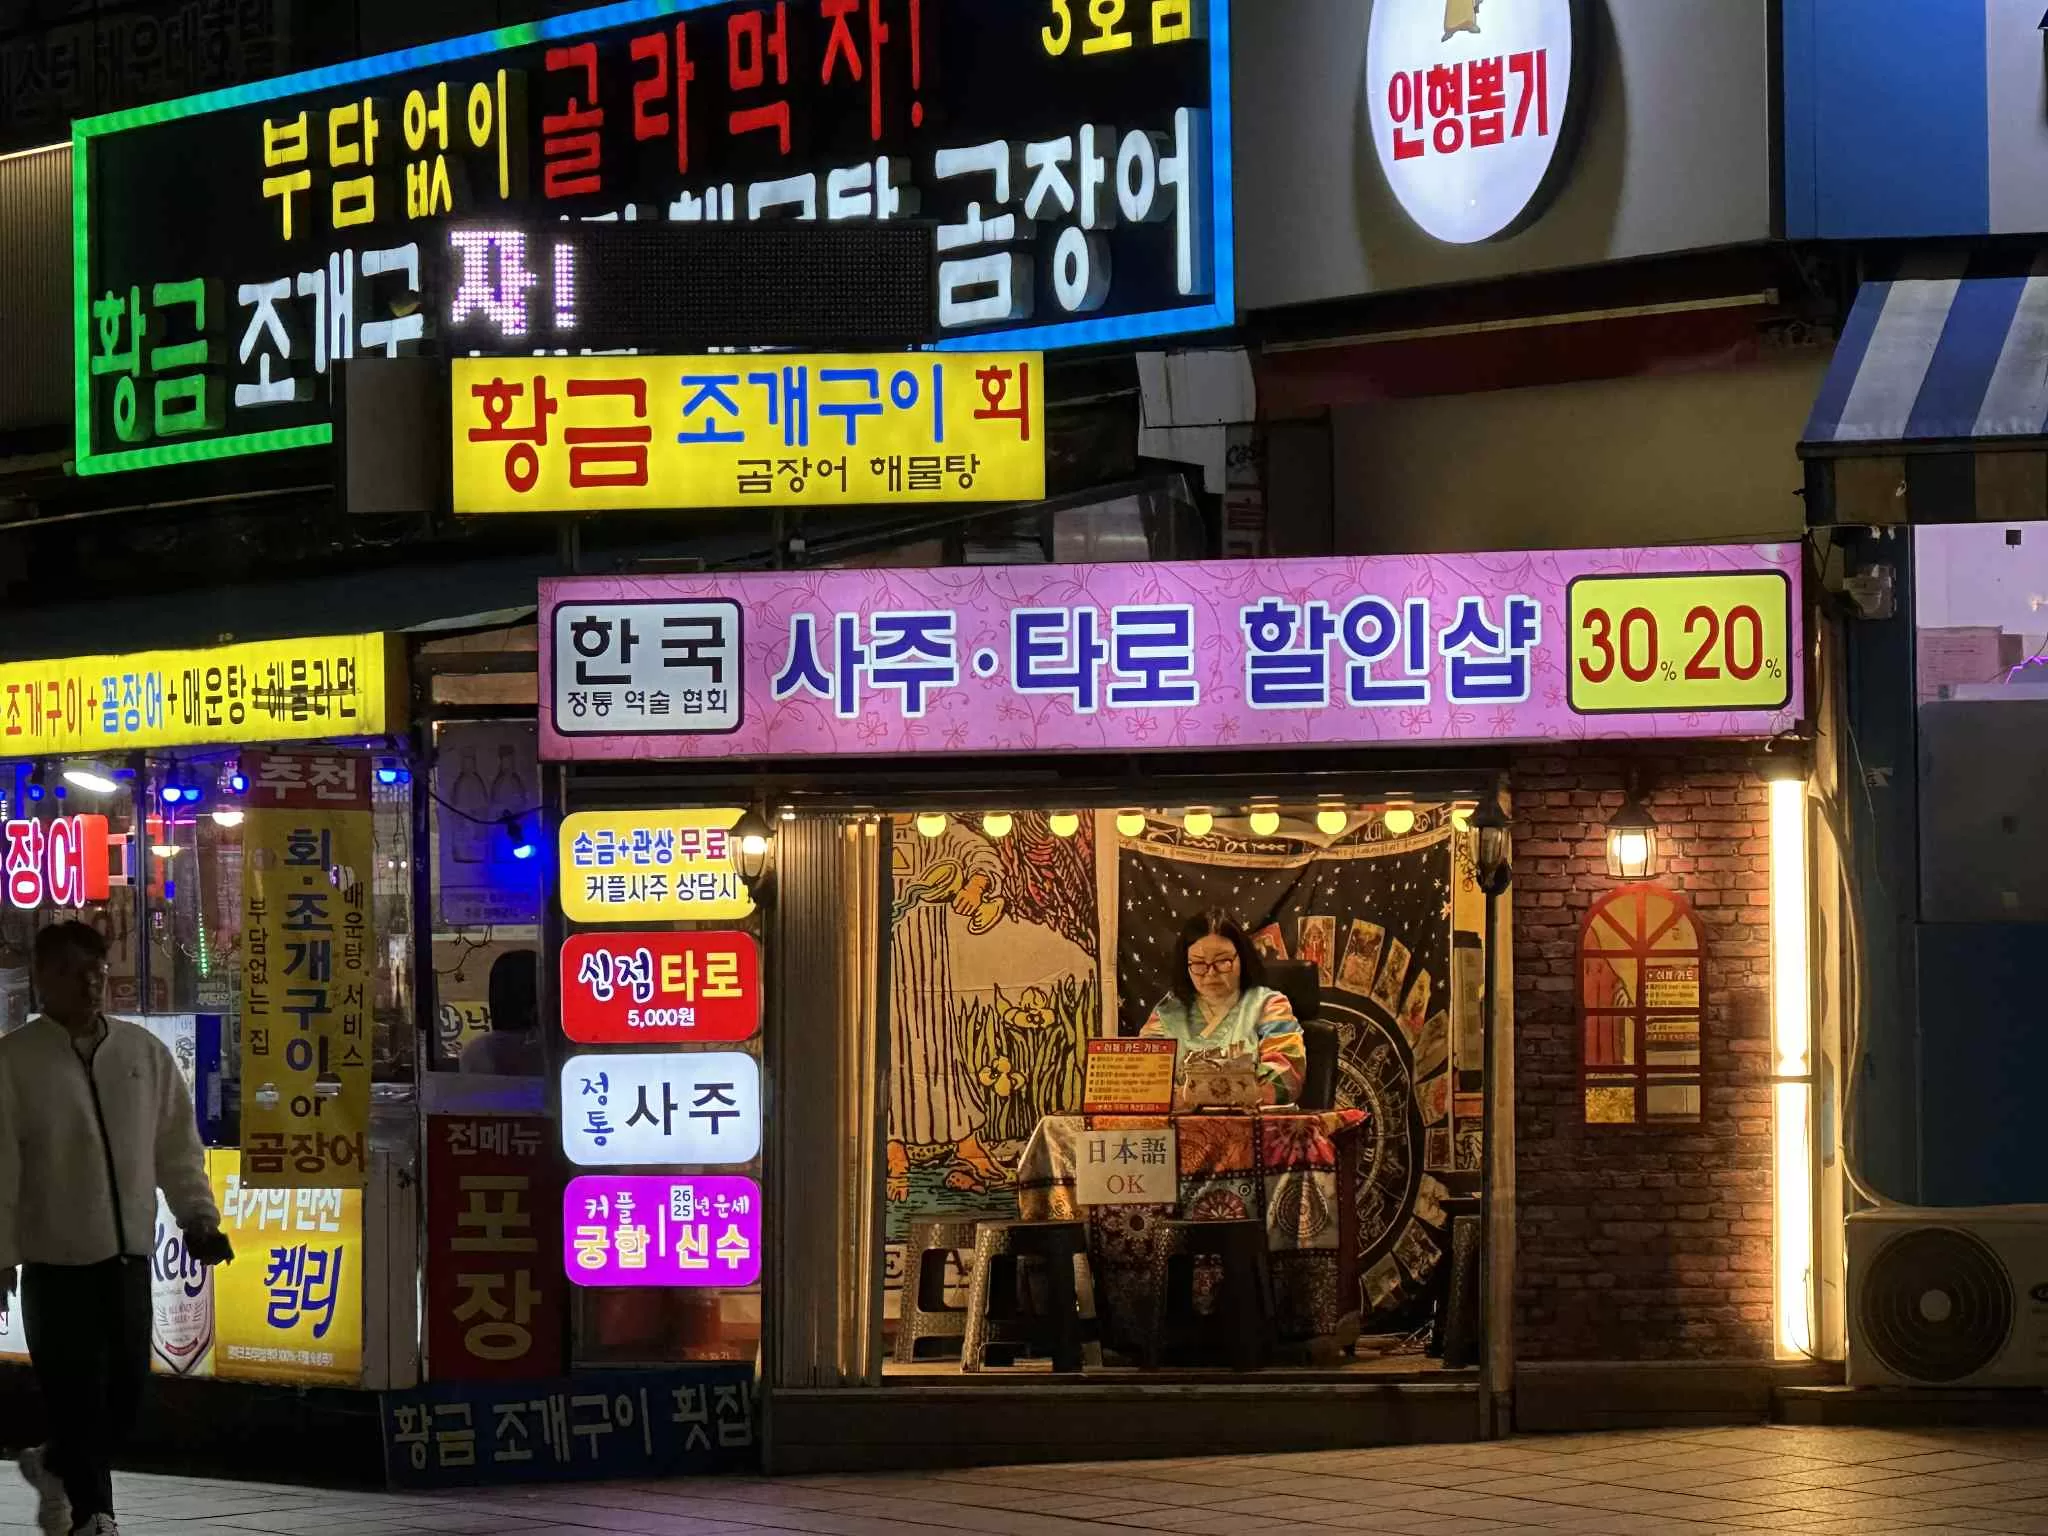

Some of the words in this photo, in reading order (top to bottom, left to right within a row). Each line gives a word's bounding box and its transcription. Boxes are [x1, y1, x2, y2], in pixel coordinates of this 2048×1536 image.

[1388, 48, 1549, 160] 인형뽑기
[262, 68, 509, 240] 부담없이
[92, 278, 208, 441] 황금
[935, 107, 1193, 328] 곰장어
[467, 376, 653, 492] 황금
[677, 363, 944, 448] 조개구이
[974, 361, 1030, 441] 회
[736, 457, 848, 495] 곰장어
[870, 453, 980, 492] 해물탕
[1240, 593, 1542, 711] 할인샵
[567, 691, 613, 718] 정통
[625, 690, 671, 716] 역술
[683, 689, 728, 715] 협회
[256, 755, 358, 801] 추천
[0, 815, 86, 910] 장어
[586, 874, 669, 904] 커플사주
[676, 873, 738, 902] 상담시
[661, 950, 743, 1002] 타로
[343, 983, 365, 1068] 서비스
[627, 1008, 696, 1028] 5,000원
[249, 1028, 269, 1057] 집
[290, 1095, 328, 1117] or
[580, 1071, 616, 1147] 정통
[625, 1081, 741, 1136] 사주
[246, 1130, 366, 1174] 곰장어
[446, 1122, 543, 1157] 전메뉴
[1088, 1135, 1167, 1166] 日本語
[585, 1191, 638, 1224] 커플
[673, 1190, 691, 1203] 26
[1106, 1174, 1146, 1195] OK
[673, 1205, 691, 1217] 25
[449, 1175, 543, 1362] 포장
[574, 1224, 651, 1270] 궁합
[675, 1224, 751, 1269] 신수
[263, 1242, 344, 1340] 켈리
[393, 1402, 476, 1471] 황금
[493, 1386, 653, 1464] 조개구이
[671, 1380, 755, 1451] 횟집
